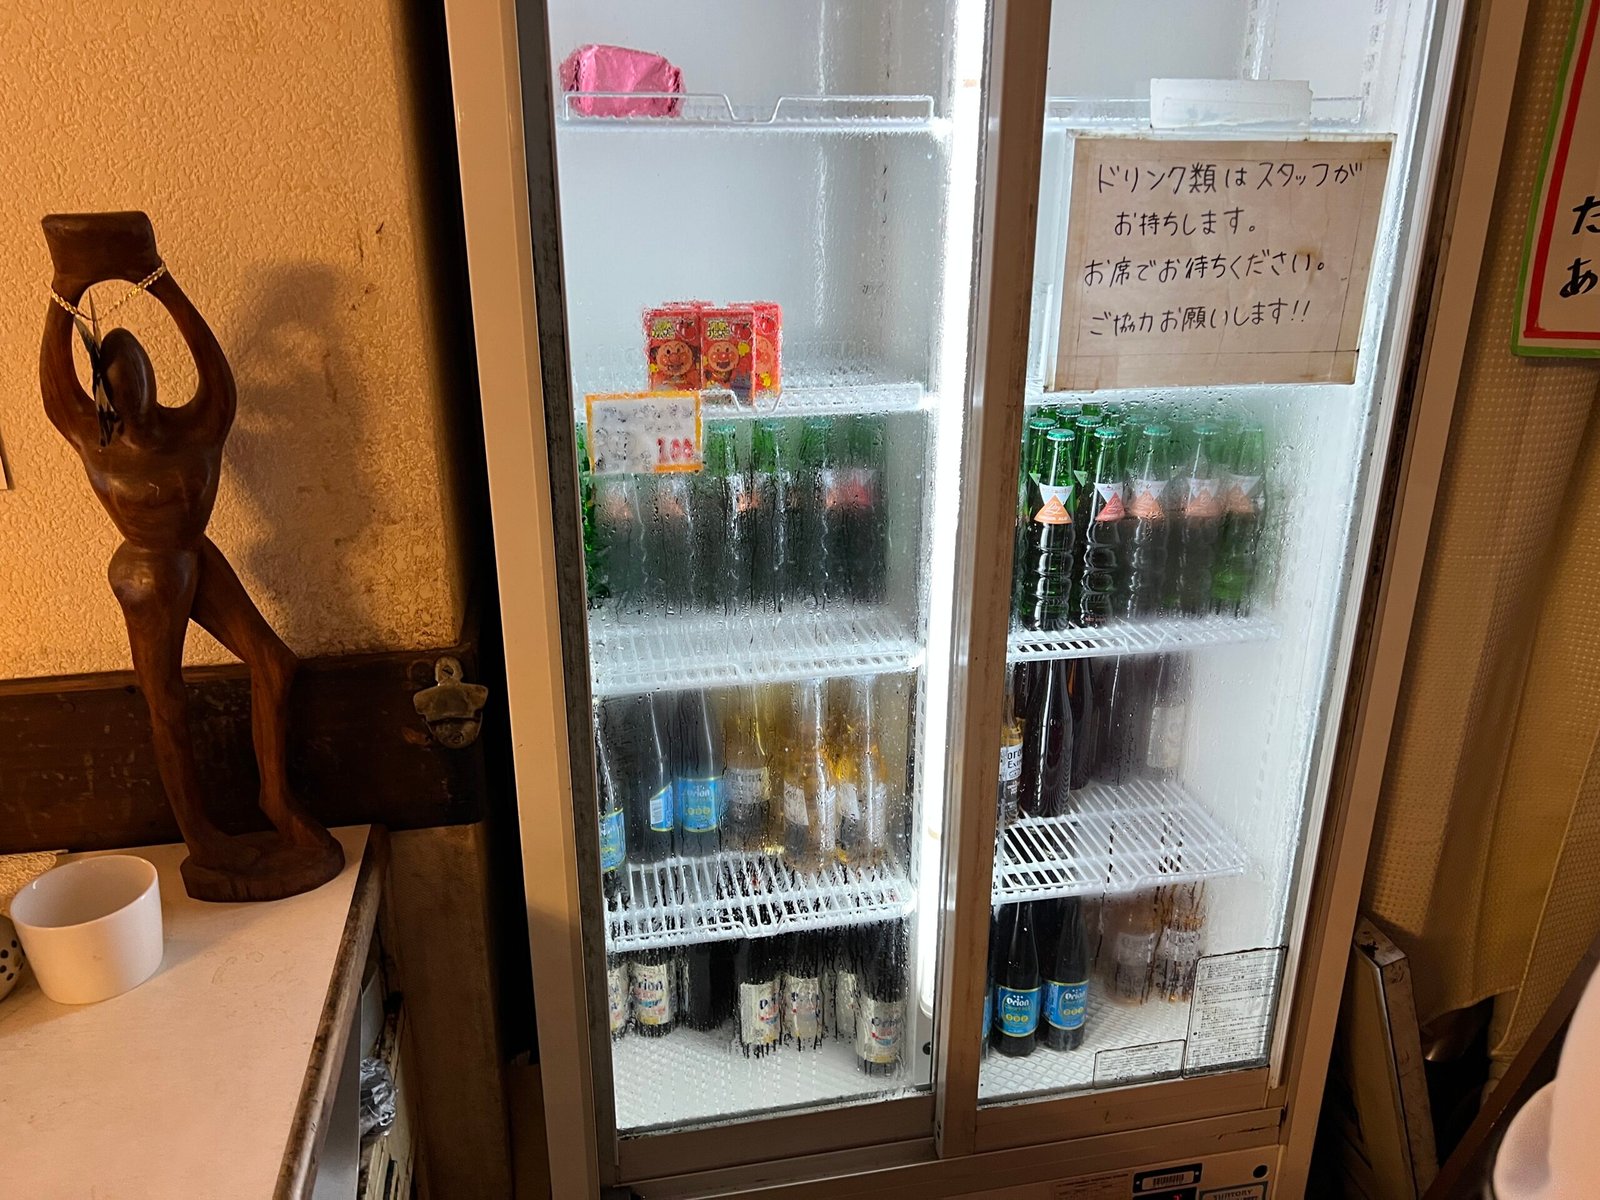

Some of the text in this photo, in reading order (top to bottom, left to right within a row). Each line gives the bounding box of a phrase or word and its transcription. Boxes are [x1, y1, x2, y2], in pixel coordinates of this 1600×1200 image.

[1097, 161, 1363, 195] ドリンク類はスタッフが
[1113, 206, 1257, 237] お持ちします。
[1084, 249, 1326, 288] お席でお待ちください。
[1006, 995, 1030, 1008] Orion
